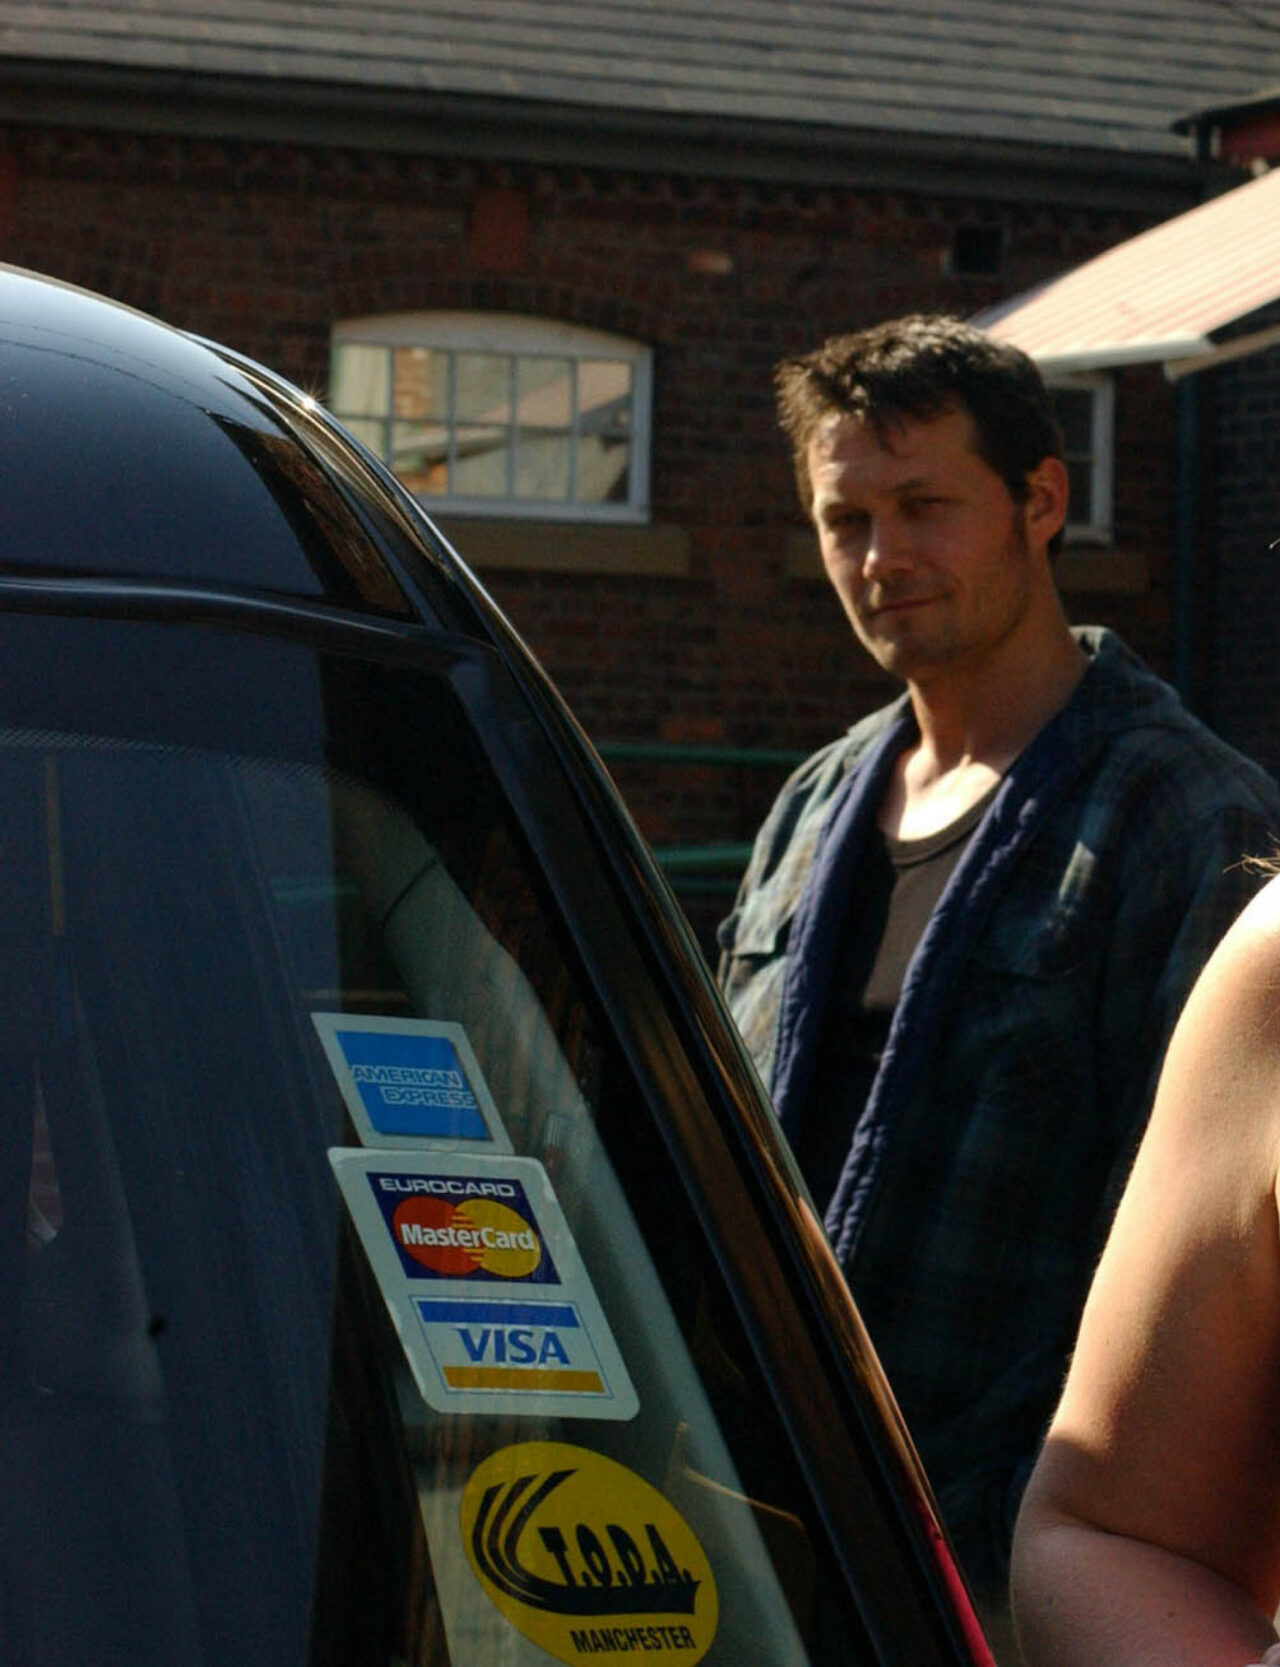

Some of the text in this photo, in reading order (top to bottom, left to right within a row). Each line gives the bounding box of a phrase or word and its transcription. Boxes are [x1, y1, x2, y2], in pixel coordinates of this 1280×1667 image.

[352, 1065, 462, 1089] AMERICAN
[382, 1087, 478, 1109] EXPRESS
[380, 1178, 515, 1197] EUROCARD
[401, 1223, 535, 1250] MasterCard
[457, 1328, 571, 1365] VISA
[570, 1626, 696, 1654] MANCHESTER
